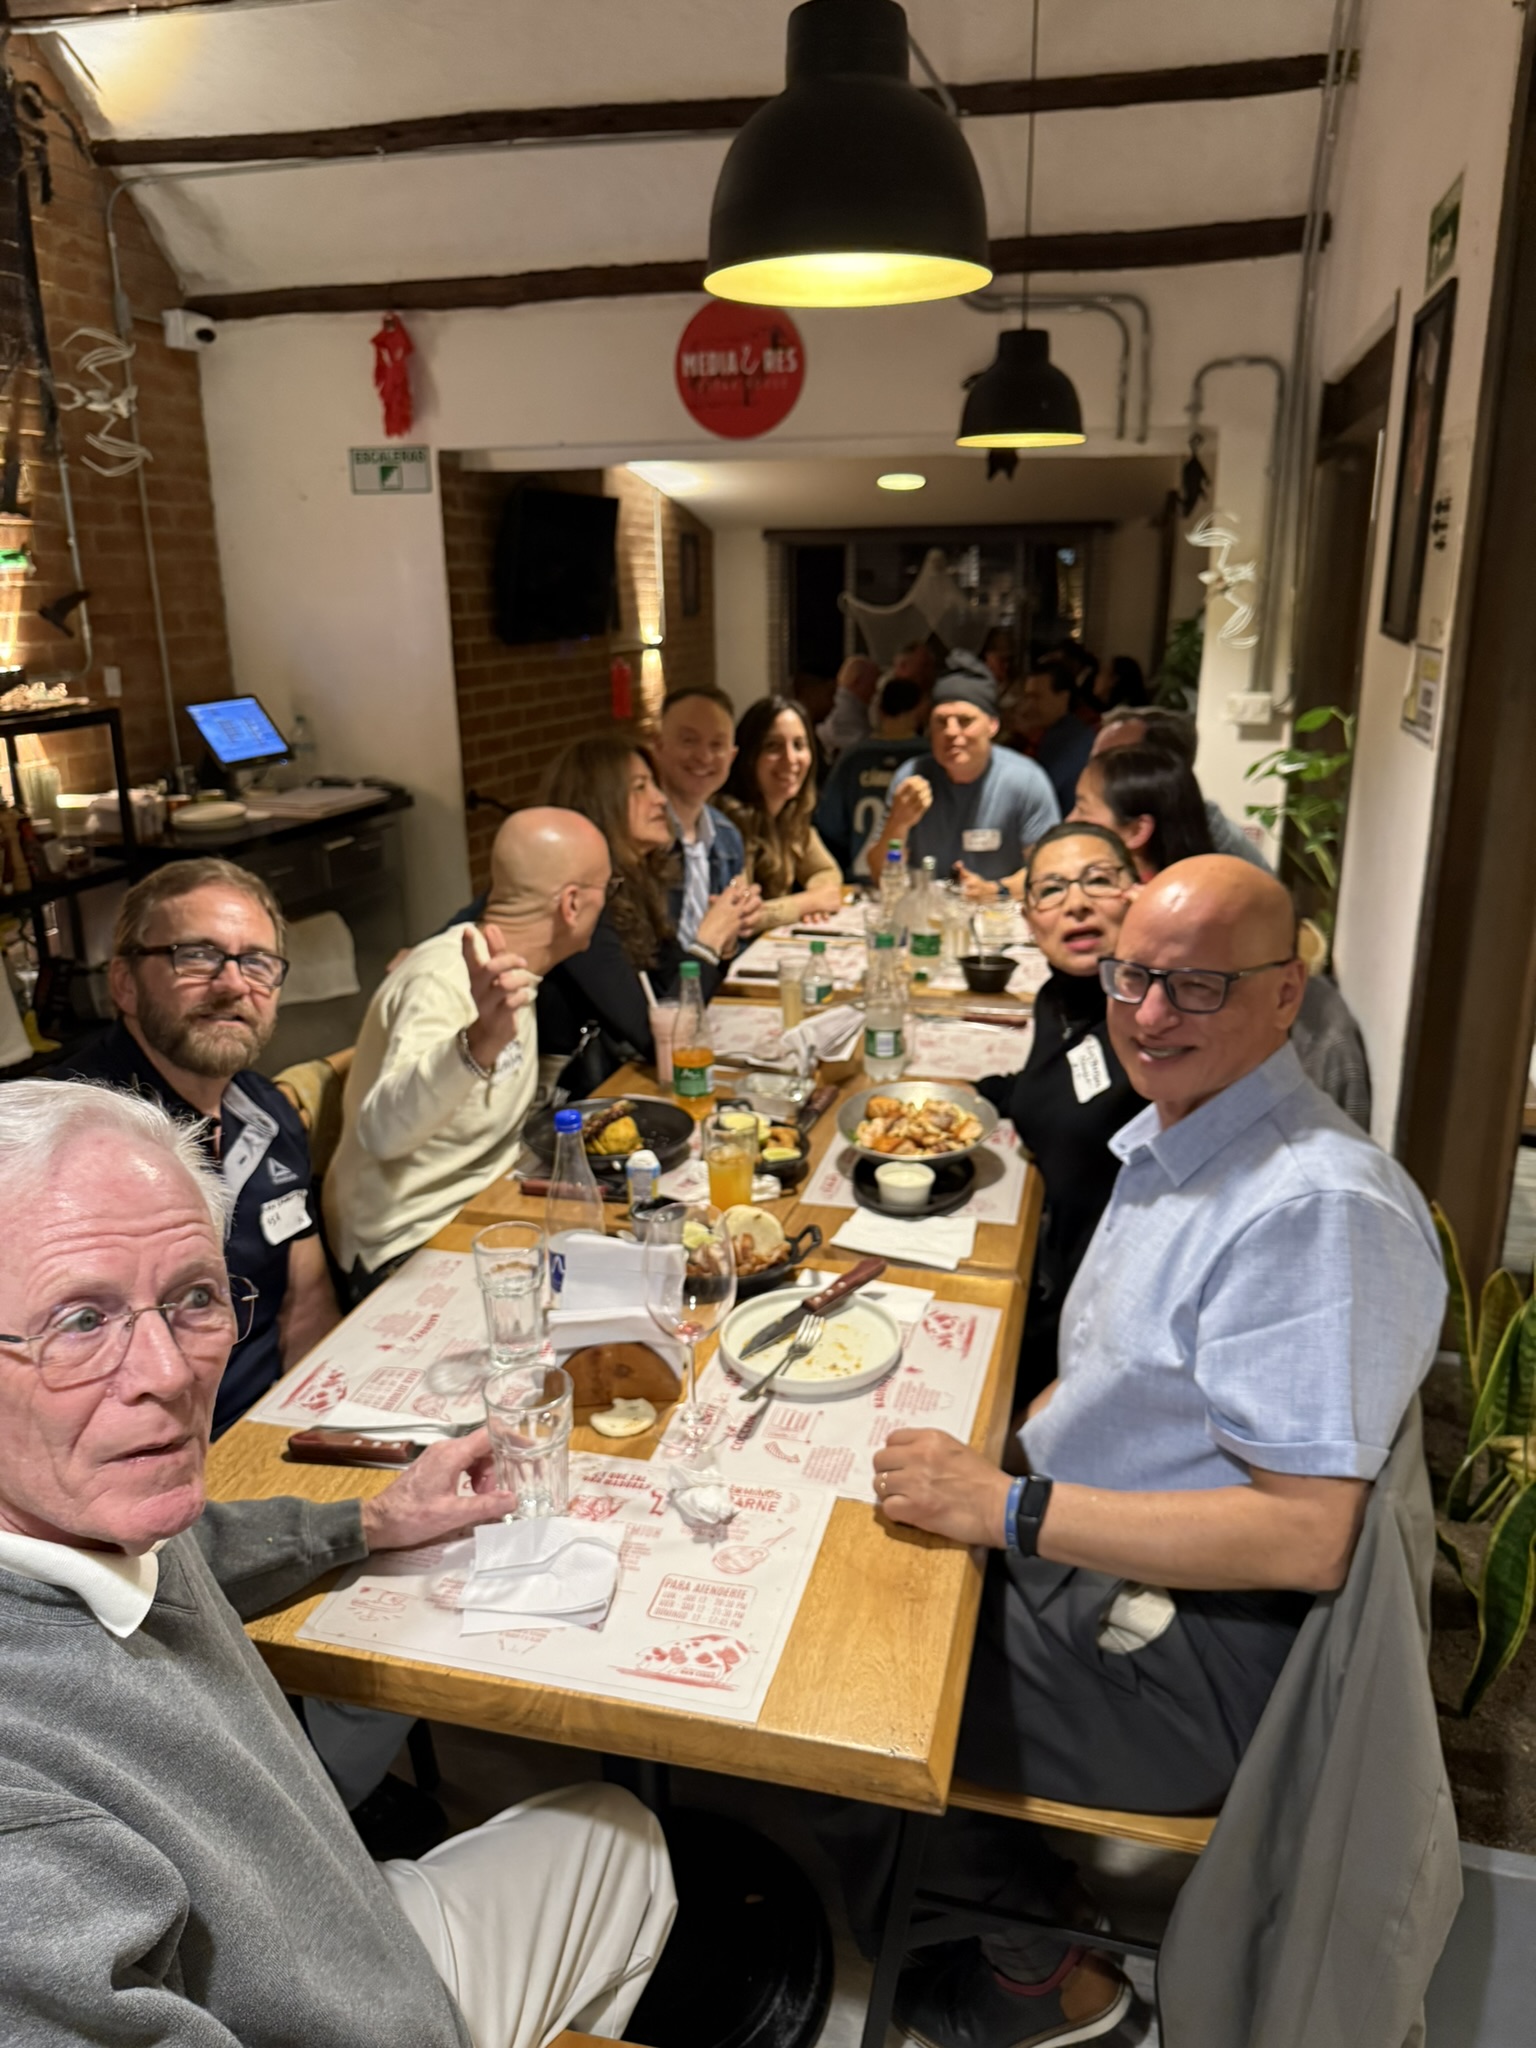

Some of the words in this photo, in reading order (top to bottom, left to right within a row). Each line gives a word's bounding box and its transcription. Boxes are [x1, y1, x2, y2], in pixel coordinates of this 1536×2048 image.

[681, 350, 739, 378] MEDIA
[762, 347, 798, 373] RES
[355, 450, 426, 464] ESCALERAS
[729, 1484, 783, 1500] ÉRMINOS
[663, 1577, 692, 1591] PARA
